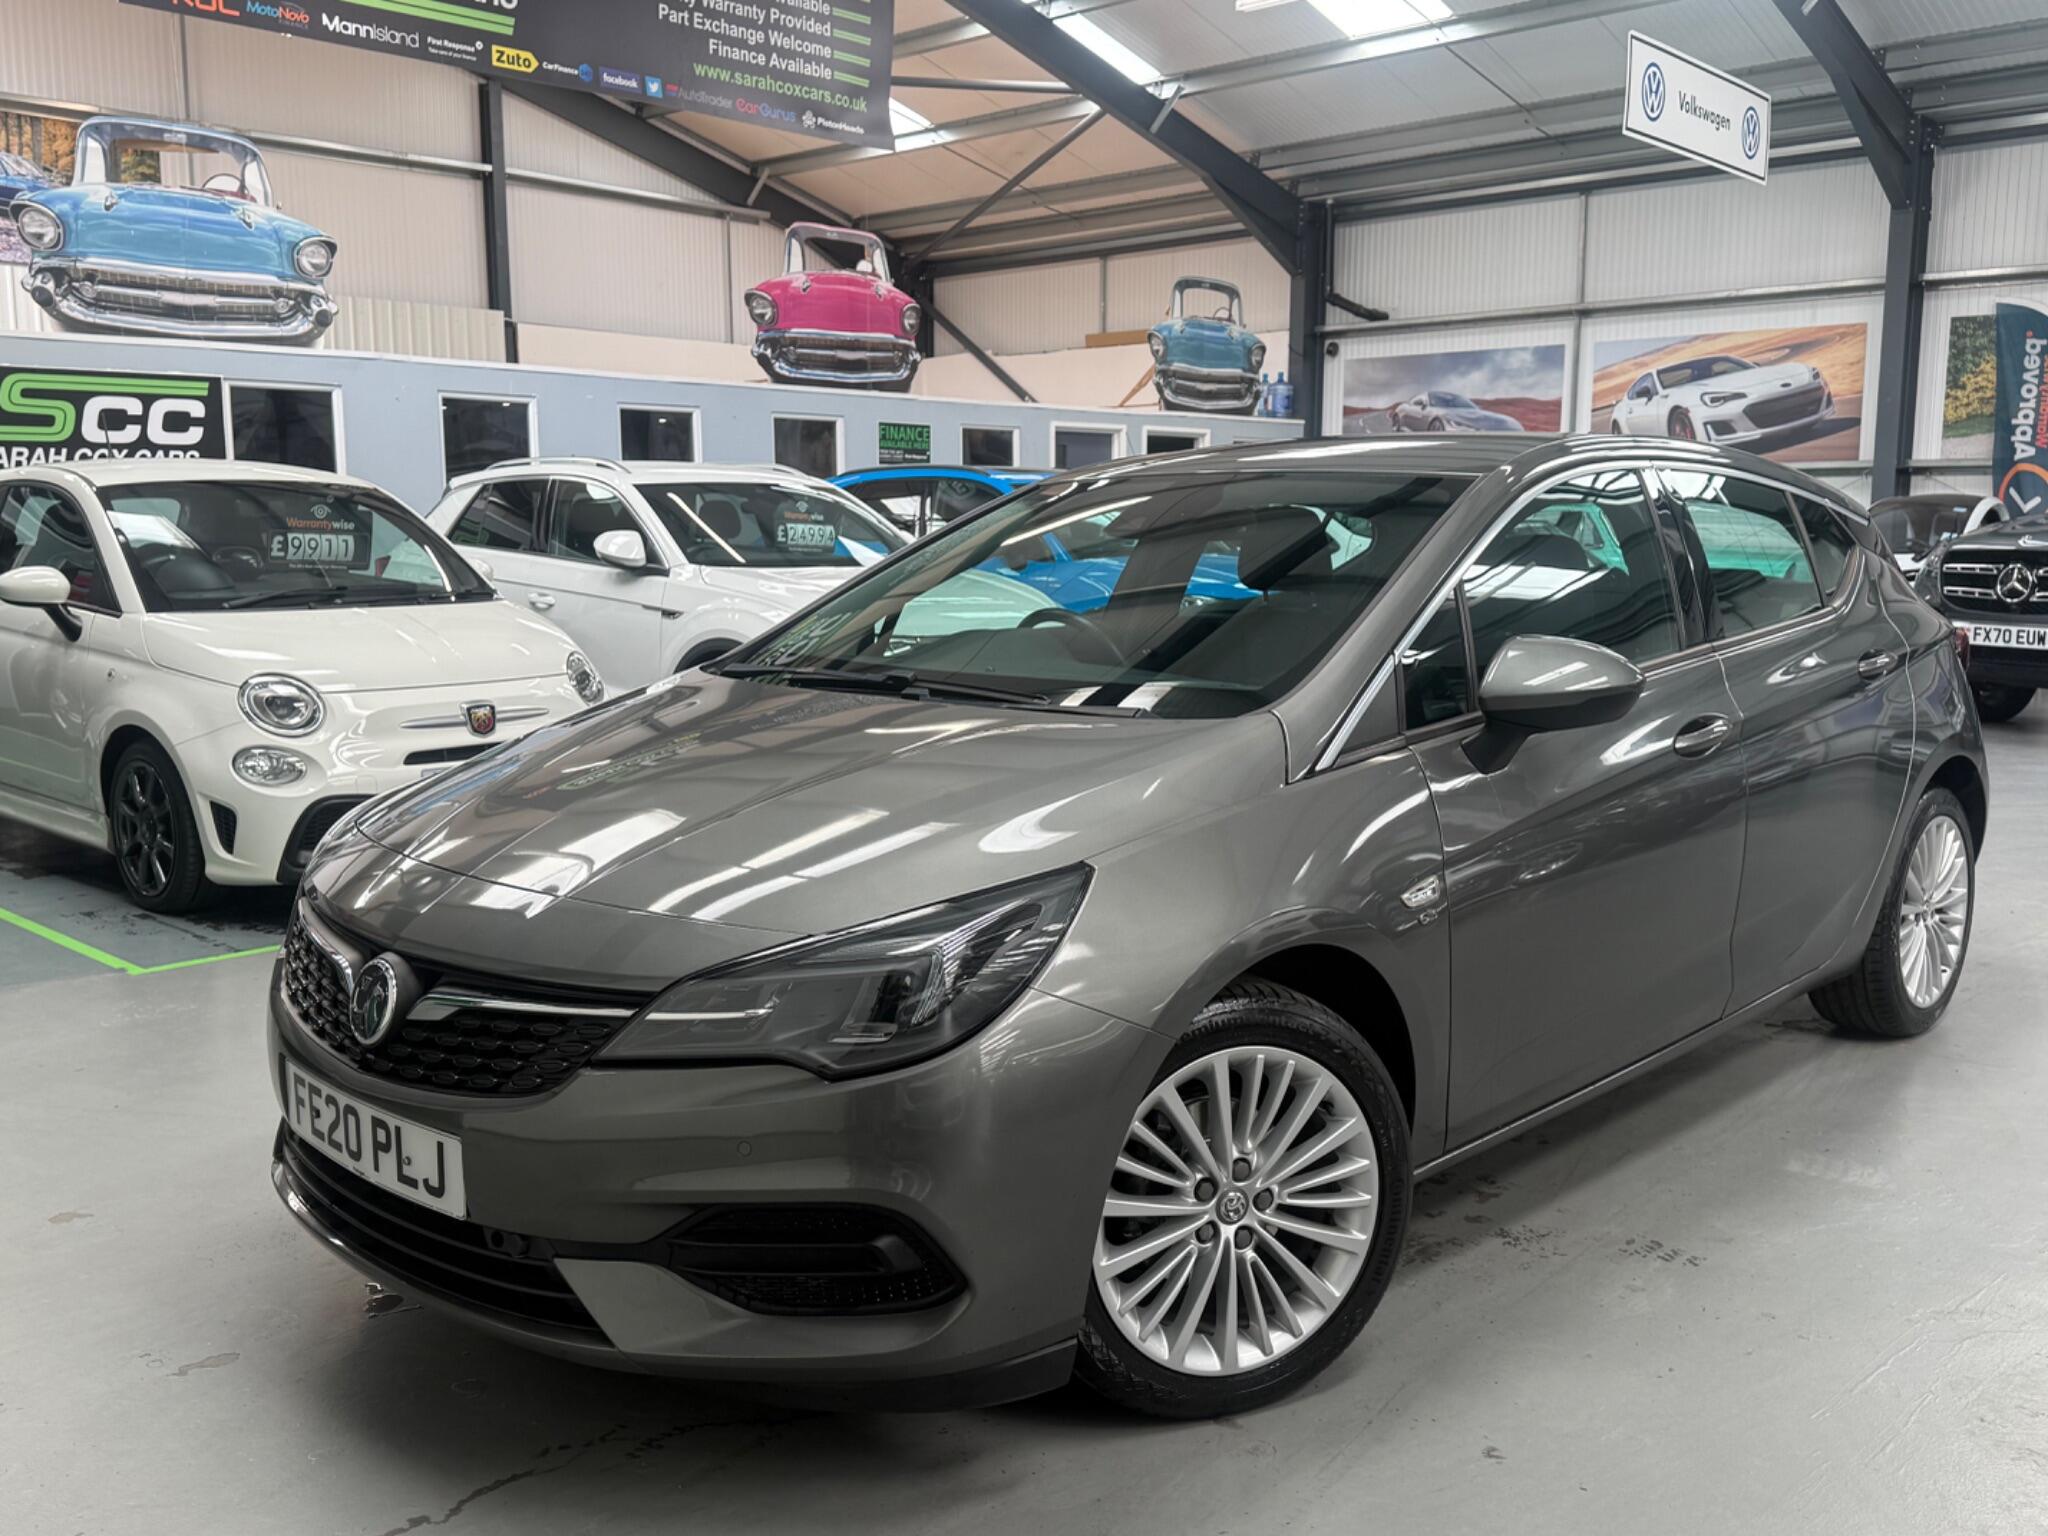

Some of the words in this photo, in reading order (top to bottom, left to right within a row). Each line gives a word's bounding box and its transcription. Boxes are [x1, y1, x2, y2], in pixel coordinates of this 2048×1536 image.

[246, 2, 310, 23] MotoNovo
[769, 8, 831, 37] Provided
[658, 3, 689, 26] Part
[693, 12, 765, 45] Exchange
[768, 29, 832, 59] Welcome
[443, 39, 475, 53] Response
[496, 50, 531, 69] Zuto
[709, 38, 766, 66] Finance
[769, 52, 832, 80] Available
[603, 72, 638, 88] facebook
[693, 62, 868, 113] www.sarahcoxcars.co.uk
[735, 97, 796, 122] CarGurus
[1679, 90, 1731, 132] Volkswagen
[0, 373, 209, 446] SCC
[880, 425, 930, 441] FINANCE
[287, 517, 355, 530] Warrantywise
[271, 535, 350, 558] £9911
[1973, 627, 2012, 645] FX70
[2016, 629, 2046, 647] EUW
[293, 1072, 362, 1163] FE20
[371, 1115, 445, 1199] PLJ
